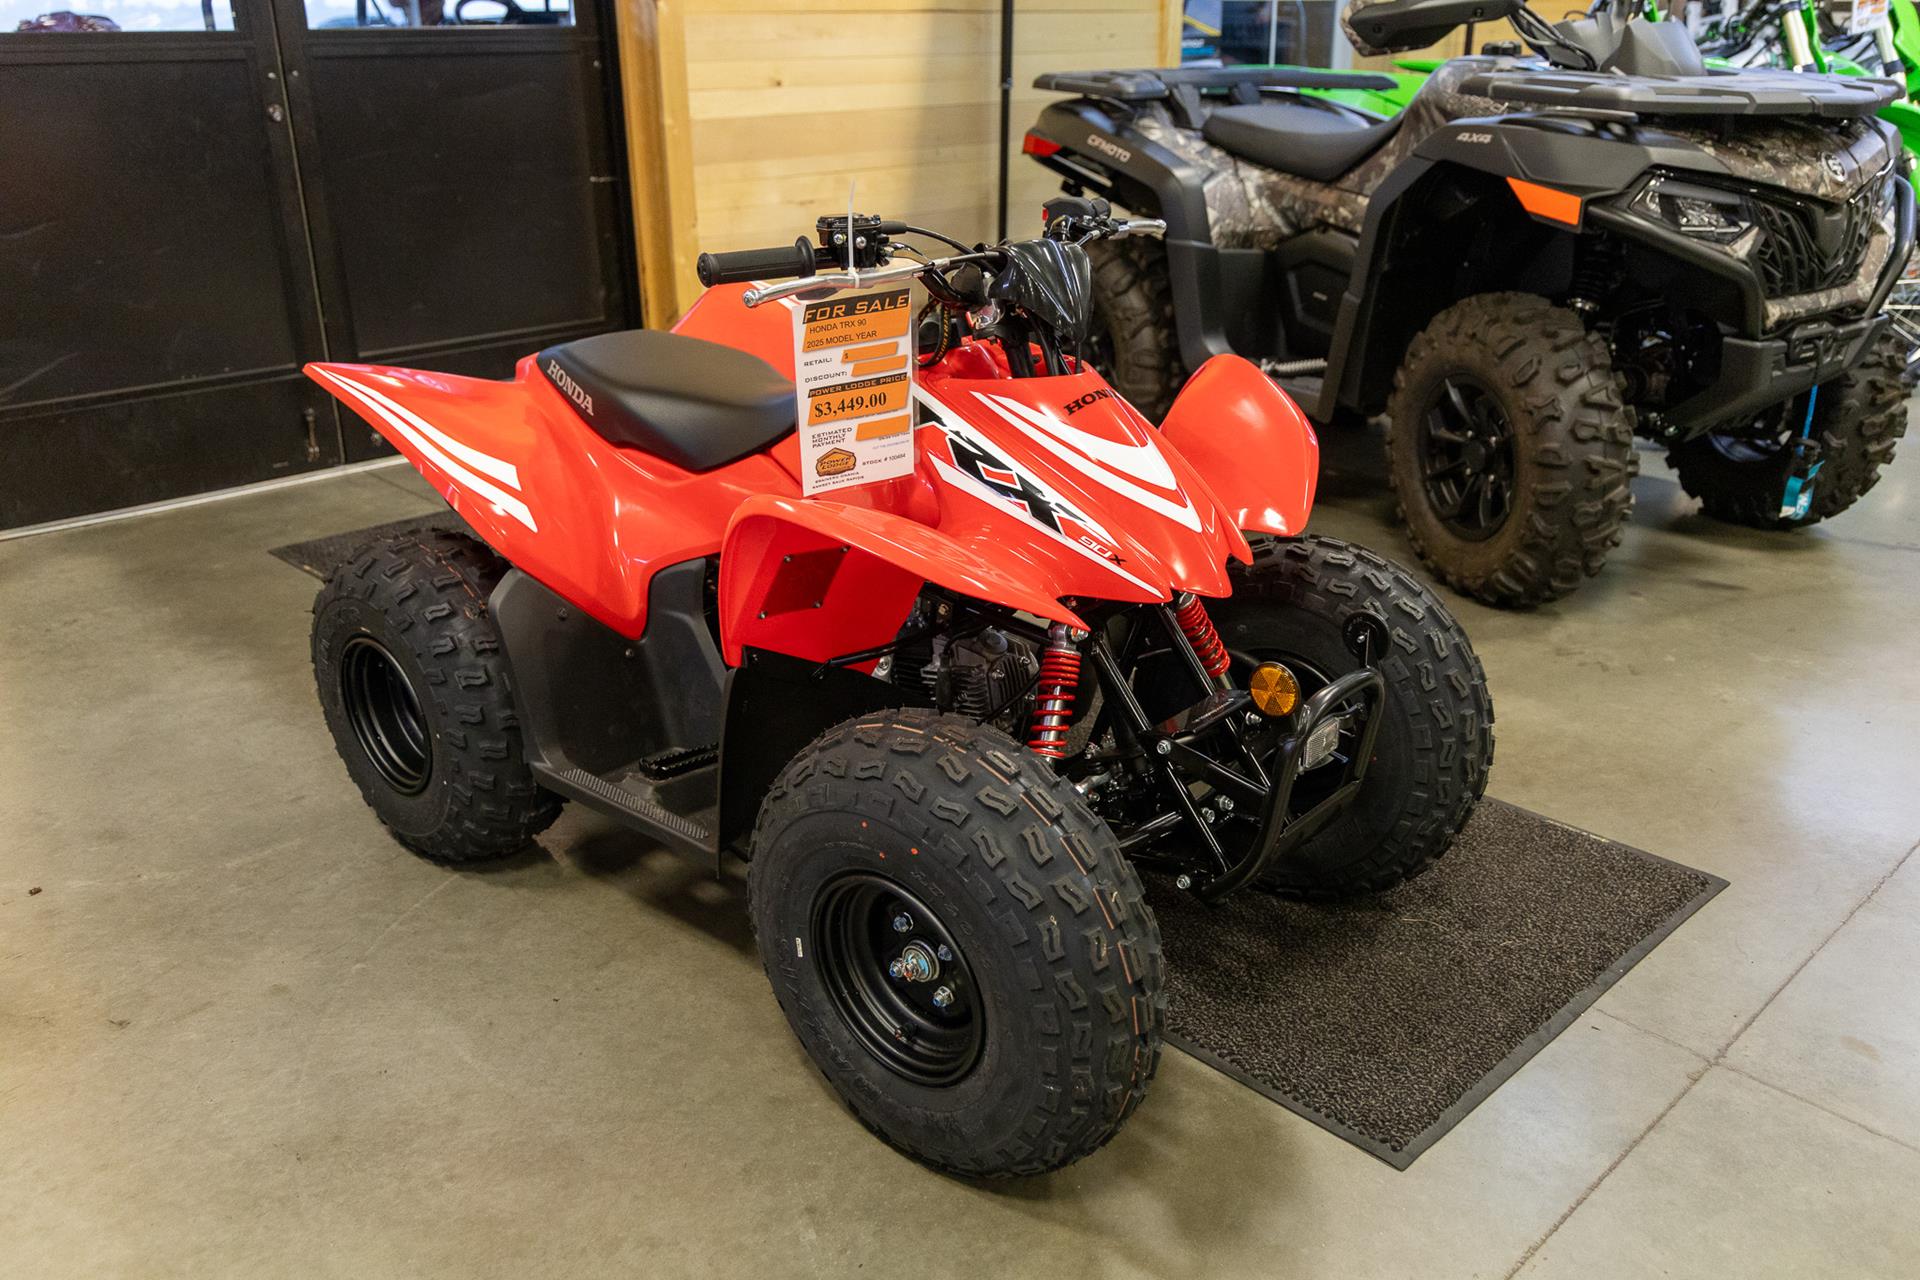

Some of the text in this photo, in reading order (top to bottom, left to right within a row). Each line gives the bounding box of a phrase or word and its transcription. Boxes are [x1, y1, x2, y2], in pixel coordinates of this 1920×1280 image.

[1456, 132, 1493, 144] 4X4
[1087, 134, 1131, 162] CFMOTO
[804, 295, 909, 323] FOR SALE
[810, 318, 867, 334] HONDA TRX 90
[807, 330, 877, 349] 2025 MODEL YEAR
[804, 357, 832, 367] RETAIL:
[805, 371, 848, 383] DISCOUNT:
[809, 373, 907, 397] POWER LODGE PRICE
[547, 359, 594, 416] HONDA
[814, 391, 887, 418] $3,449.00
[811, 427, 853, 440] ESTIMATED
[812, 433, 846, 443] MONTHLY
[812, 438, 846, 449] PAYMENT
